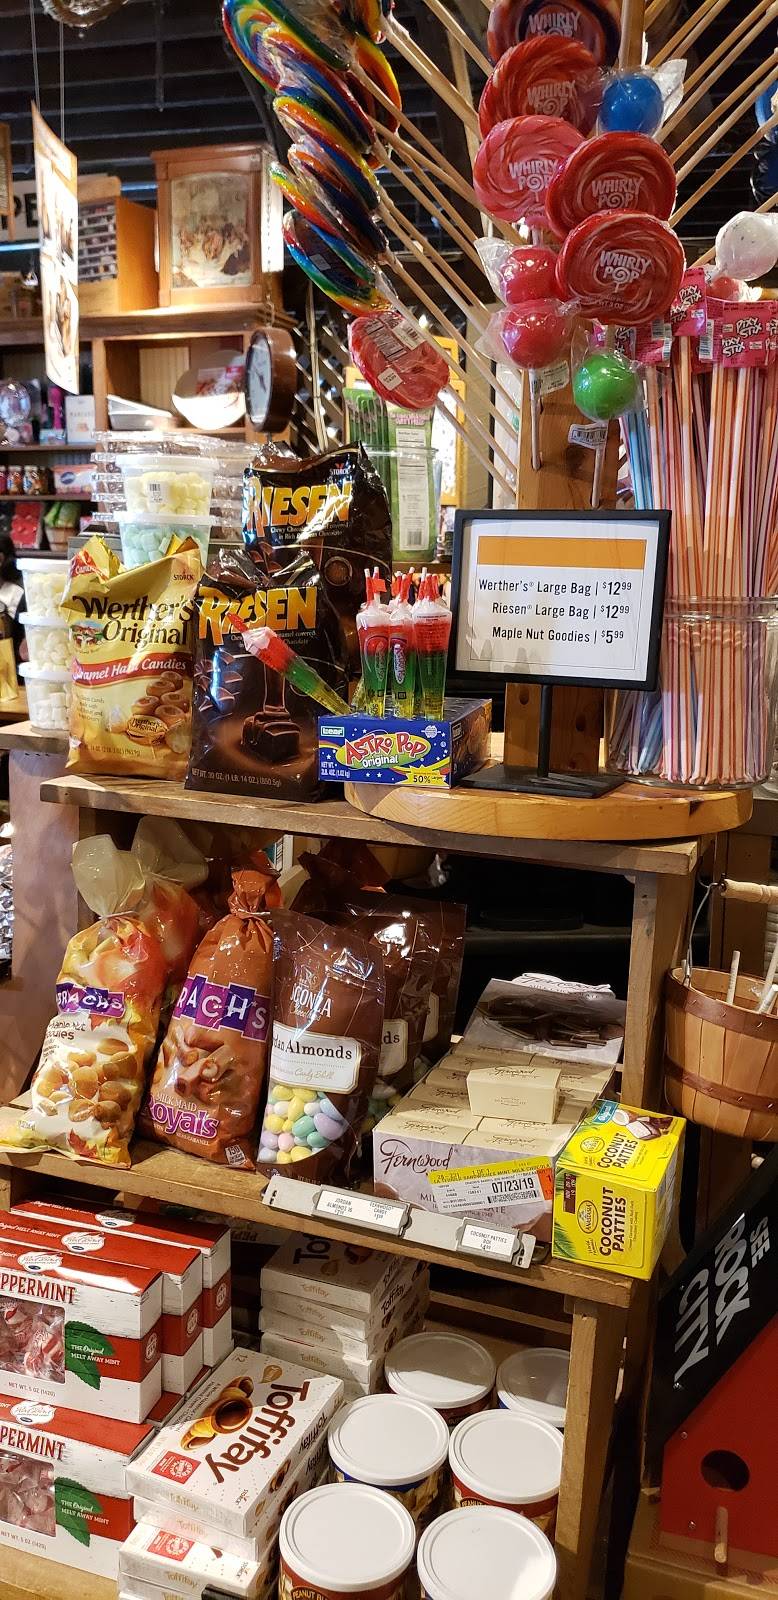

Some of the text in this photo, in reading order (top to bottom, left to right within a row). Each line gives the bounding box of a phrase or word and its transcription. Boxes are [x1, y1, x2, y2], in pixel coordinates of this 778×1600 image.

[528, 12, 579, 33] WHIRLY
[526, 81, 577, 101] WHIRLY
[508, 158, 559, 179] WHIRLY
[591, 177, 645, 197] WHIRLY
[599, 250, 651, 273] WHIRLY
[603, 266, 639, 286] POP
[246, 476, 353, 538] RIESEN
[537, 581, 567, 595] Large
[570, 582, 591, 597] Bag
[72, 594, 194, 622] Werther's
[535, 604, 565, 618] Large
[569, 605, 589, 619] Bag
[103, 619, 188, 649] Original
[492, 627, 523, 640] Maple
[526, 628, 545, 640] Nut
[548, 629, 590, 643] Goodies
[142, 658, 187, 671] Candies
[413, 774, 431, 784] 50%
[286, 1039, 353, 1060] Almonds
[176, 1097, 198, 1112] MAID
[380, 1138, 454, 1175] Fernwood
[597, 1132, 627, 1169] COCONUT
[612, 1139, 639, 1169] PATTIES
[491, 1177, 535, 1194] 07/23/19
[599, 1186, 614, 1257] COCONUT
[612, 1197, 627, 1253] PATTIES
[750, 1216, 771, 1269] SEE
[714, 1216, 750, 1346] ROCK
[674, 1268, 709, 1383] CITY
[70, 1353, 121, 1367] MELT AWAY MINT
[83, 1345, 105, 1356] Original
[203, 1381, 311, 1484] Toffifay
[61, 1499, 73, 1507] THE
[61, 1508, 110, 1525] MELT AWAY MINT
[292, 1589, 316, 1600] PEANUT
